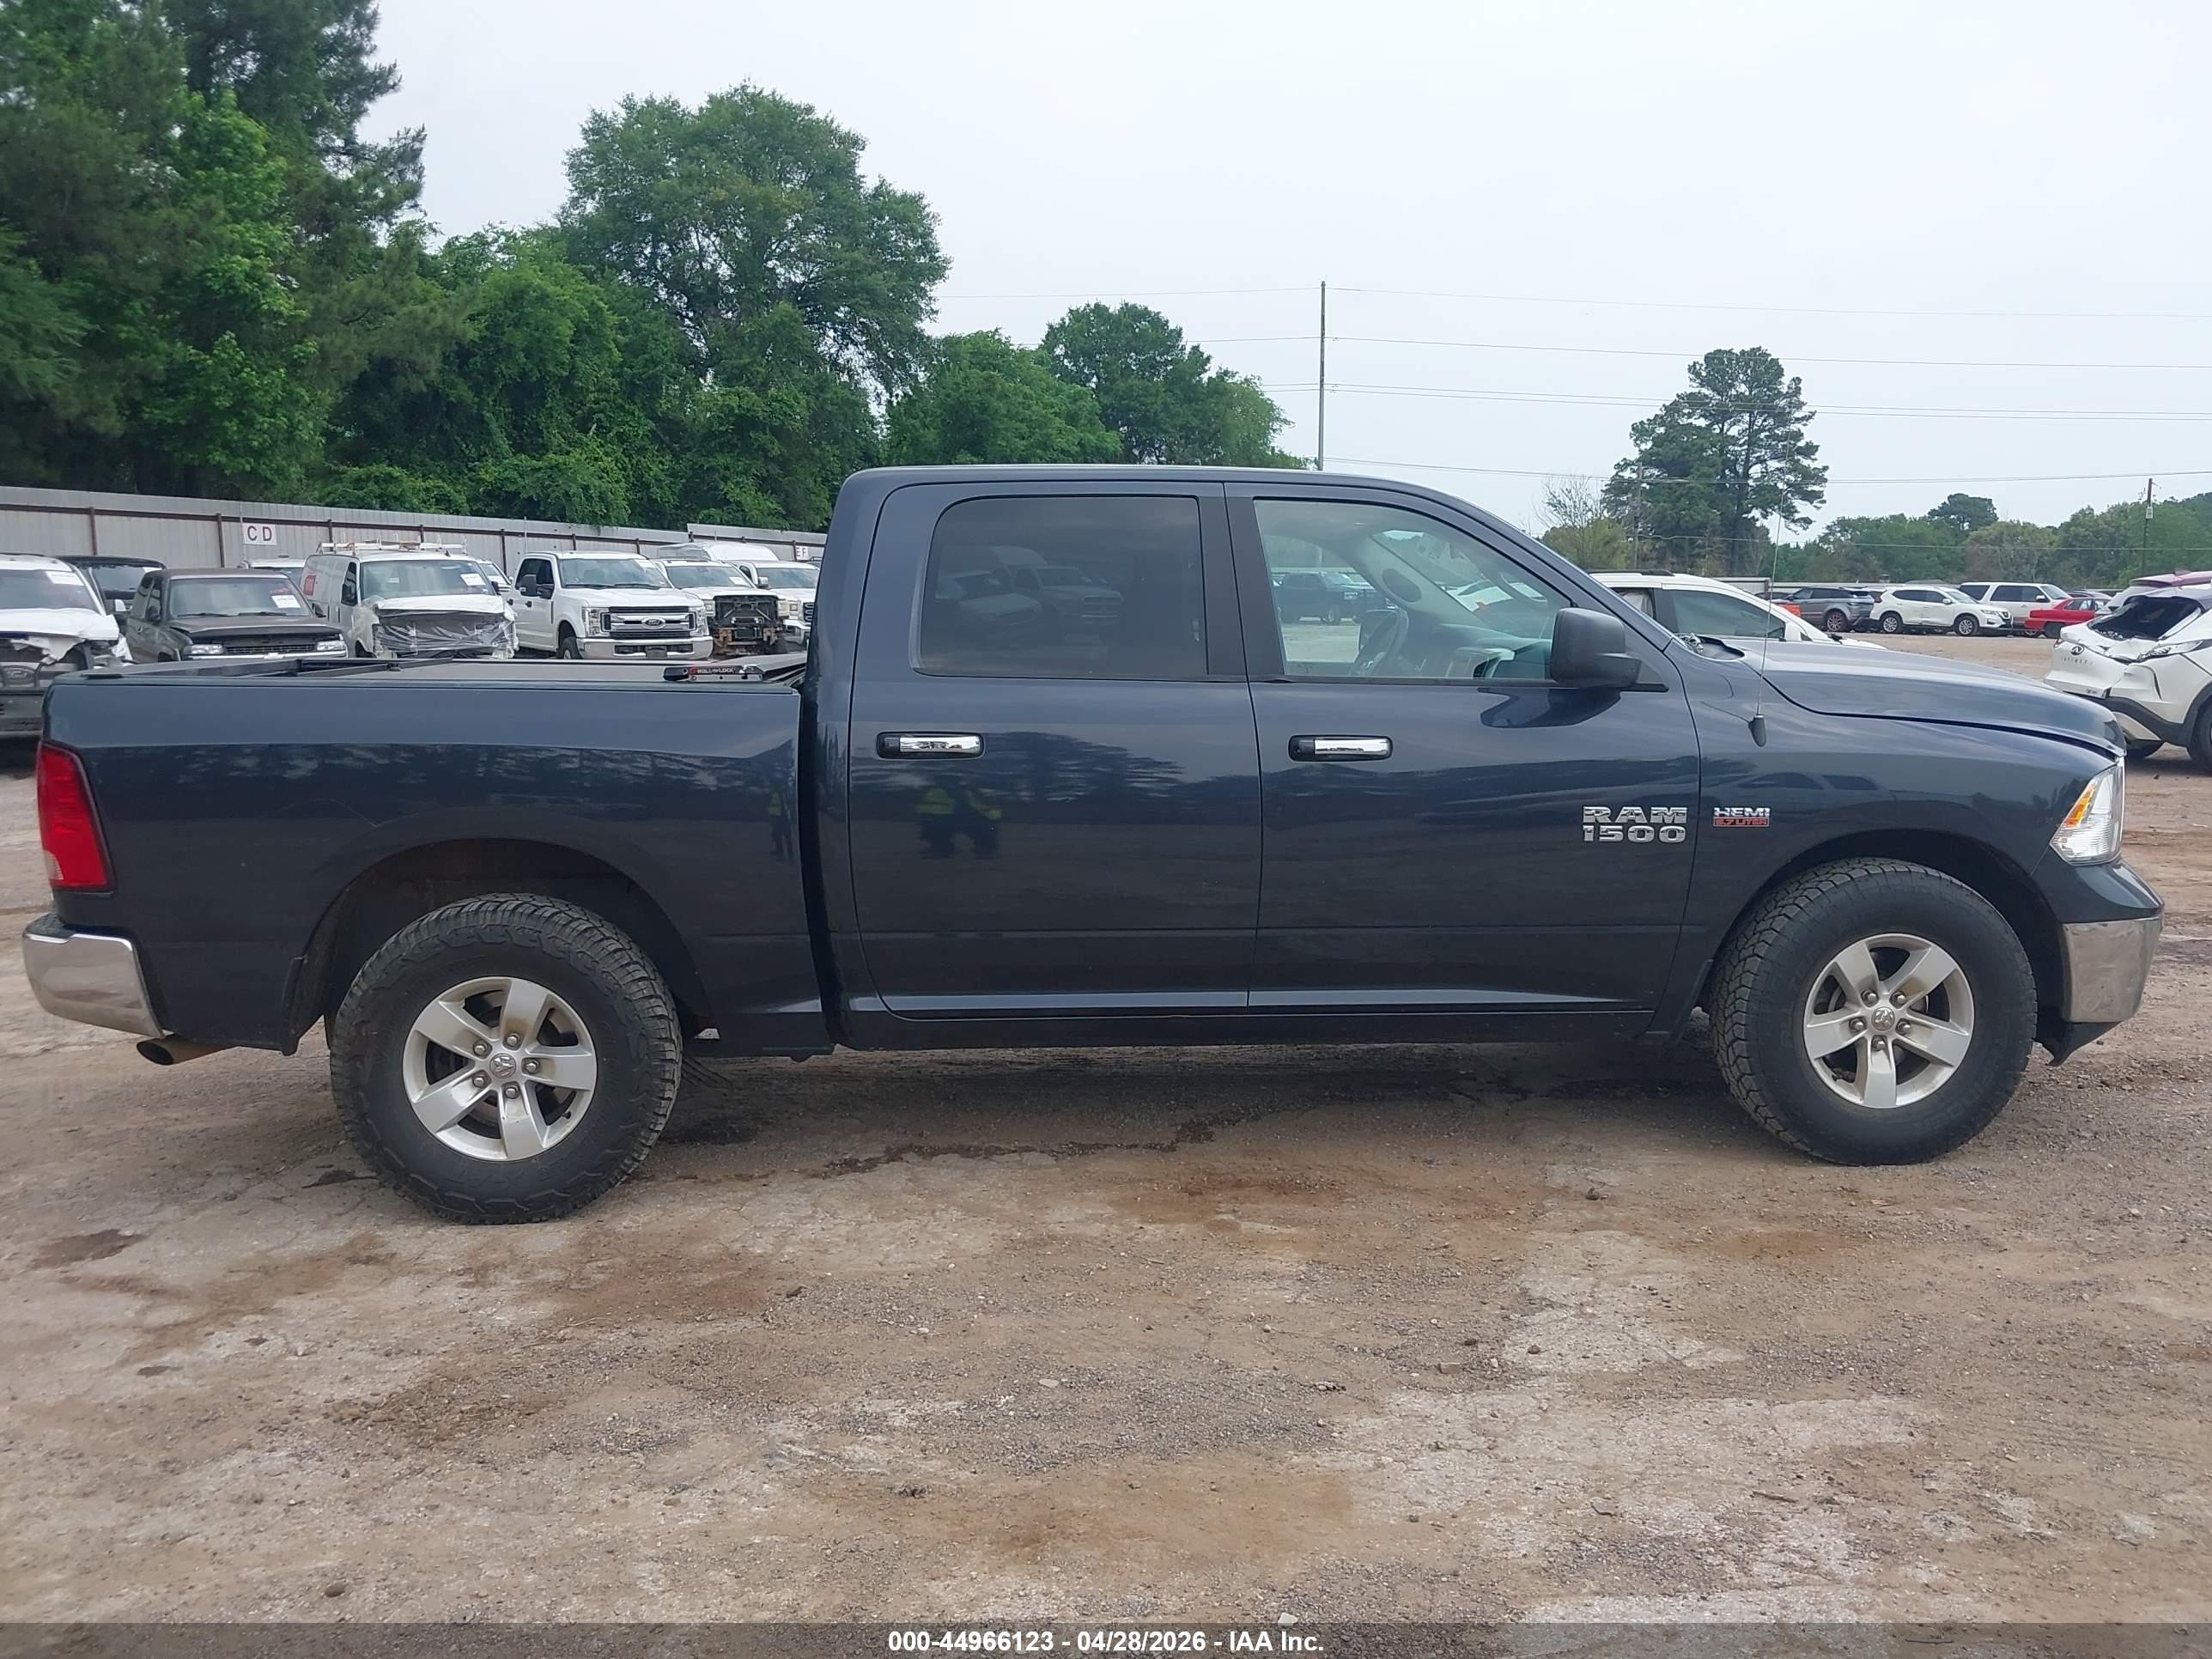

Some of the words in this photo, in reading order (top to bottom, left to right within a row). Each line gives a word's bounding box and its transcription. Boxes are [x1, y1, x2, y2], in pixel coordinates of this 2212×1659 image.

[1583, 805, 1688, 824] RAM
[1713, 806, 1771, 817] HEMI
[1583, 824, 1686, 843] 1500
